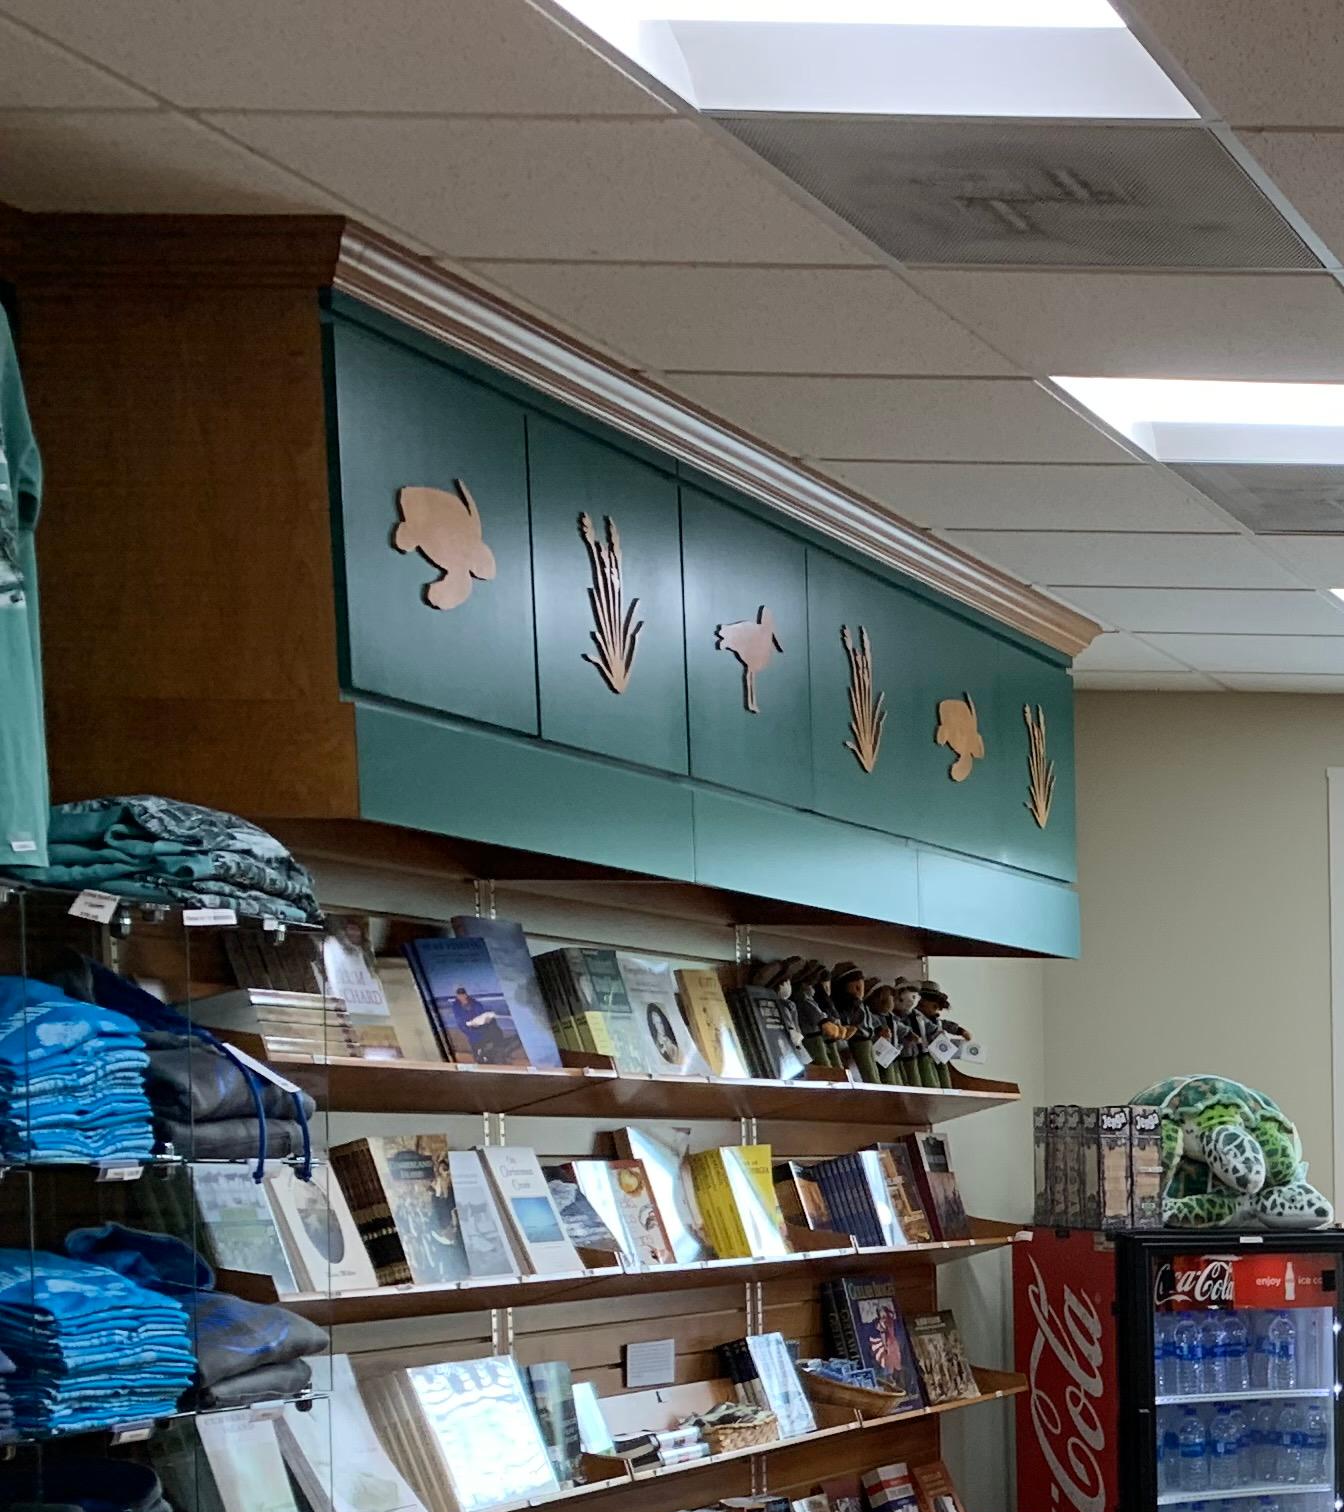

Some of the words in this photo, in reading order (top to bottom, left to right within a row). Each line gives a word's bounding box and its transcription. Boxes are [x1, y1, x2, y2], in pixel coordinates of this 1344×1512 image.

[1154, 1261, 1236, 1306] Ca-Cola
[1256, 1277, 1282, 1287] enjoy
[1298, 1276, 1312, 1285] ice
